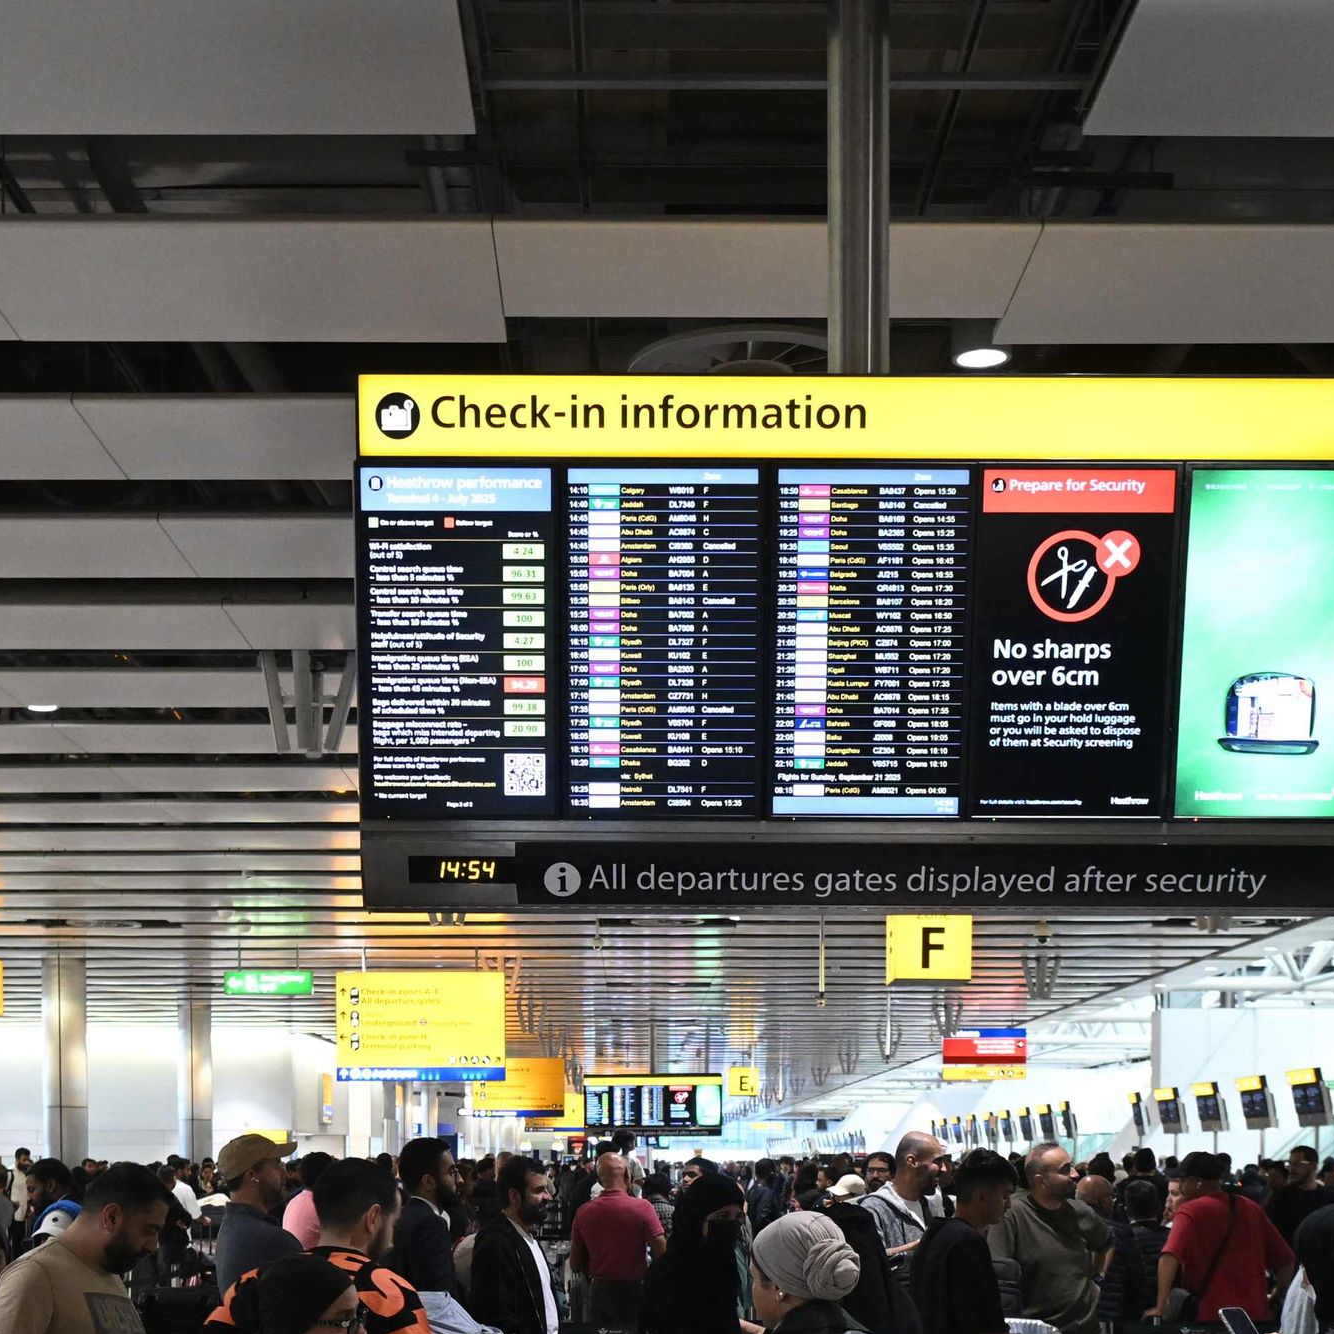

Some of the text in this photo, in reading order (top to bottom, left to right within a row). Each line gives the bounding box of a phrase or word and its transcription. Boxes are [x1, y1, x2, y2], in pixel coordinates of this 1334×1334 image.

[432, 395, 866, 429] Check-in information
[386, 476, 543, 492] Heathrow performance
[1009, 479, 1145, 494] Prepare for Security
[621, 487, 644, 495] Calgary
[369, 550, 403, 559] (out of 5)
[513, 547, 534, 556] 4.24
[511, 570, 536, 579] 96.31
[570, 583, 588, 591] 15:05
[911, 585, 933, 593] Opens
[511, 592, 537, 601] 99.63
[516, 615, 533, 623] 100
[514, 637, 534, 645] 4.27
[994, 639, 1111, 664] No sharps
[516, 659, 533, 667] 100
[909, 667, 930, 675] Opens
[992, 666, 1099, 686] over 6cm
[512, 703, 538, 711] 99.38
[991, 702, 1018, 711] Items
[1020, 702, 1043, 711] with
[1054, 701, 1082, 711] blade
[1108, 702, 1129, 711] 6cm
[908, 707, 929, 715] Opens
[990, 713, 1135, 725] must go in your hold luggage
[512, 725, 538, 733] 20.90
[1003, 727, 1022, 736] you
[1024, 726, 1042, 734] will
[1044, 726, 1057, 735] be
[1059, 726, 1088, 735] asked
[1090, 726, 1101, 735] to
[1103, 726, 1141, 737] dispose
[989, 736, 1133, 749] of them at Security screening
[778, 773, 901, 782] Flights for Sunday, September 21 2025
[1111, 797, 1149, 805] Heathrow
[440, 861, 495, 879] 14:54
[589, 864, 1266, 898] All departures gates displayed after security
[922, 927, 945, 968] F
[376, 998, 416, 1006] departure
[740, 1076, 748, 1090] E
